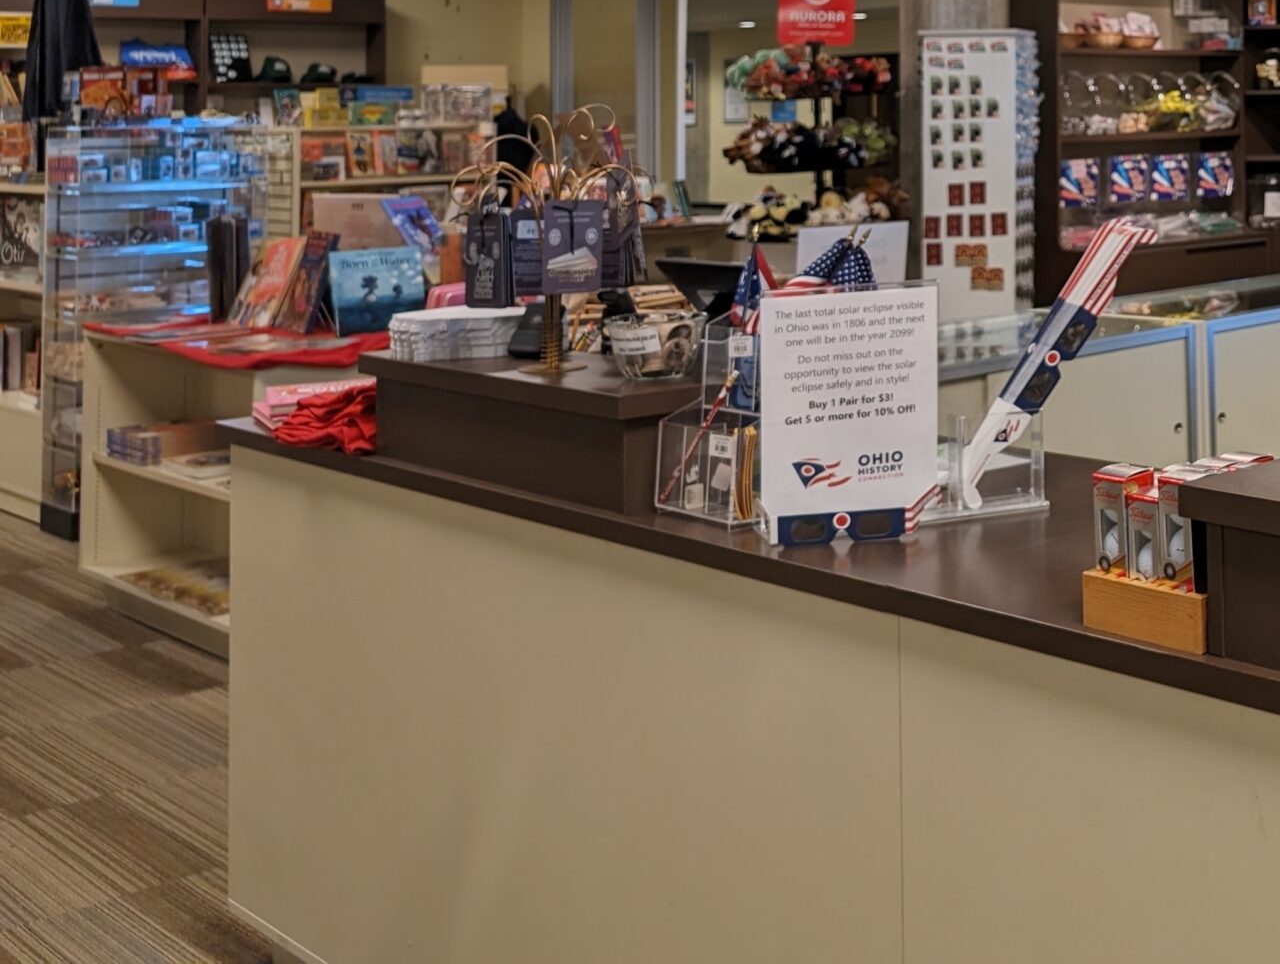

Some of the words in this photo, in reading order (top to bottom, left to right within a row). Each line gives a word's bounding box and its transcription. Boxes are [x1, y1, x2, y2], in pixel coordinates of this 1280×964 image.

[789, 10, 846, 24] AURORA
[776, 310, 792, 319] The
[795, 309, 812, 318] last
[814, 307, 836, 317] total
[838, 306, 860, 315] solar
[864, 304, 894, 315] eclipse
[897, 300, 925, 310] visible
[774, 325, 783, 334] in
[786, 323, 809, 333] Ohio
[832, 320, 841, 329] in
[844, 318, 866, 328] 1806
[868, 316, 886, 327] and
[888, 316, 903, 325] the
[906, 314, 925, 323] next
[786, 338, 803, 347] one
[806, 334, 822, 345] will
[824, 334, 837, 344] be
[839, 333, 848, 343] in
[850, 332, 865, 342] the
[868, 332, 887, 343] year
[890, 328, 915, 339] 2099!
[798, 355, 812, 364] Do
[814, 354, 830, 363] not
[833, 352, 853, 361] miss
[856, 351, 872, 360] out
[874, 350, 887, 358] on
[888, 347, 904, 357] the
[784, 366, 840, 381] opportunity
[842, 366, 853, 375] to
[854, 364, 876, 374] view
[878, 362, 893, 371] the
[895, 360, 917, 370] solar
[792, 381, 824, 394] eclipse
[826, 378, 853, 391] safely
[855, 376, 873, 387] and
[875, 375, 884, 385] in
[886, 374, 910, 386] style!
[808, 400, 828, 411] Buy
[831, 399, 836, 407] 1
[840, 396, 859, 406] Pair
[861, 394, 876, 404] for
[878, 392, 894, 404] $3!
[785, 415, 803, 426] Get
[806, 414, 812, 424] 5
[814, 414, 826, 423] or
[828, 411, 854, 422] more
[856, 409, 872, 419] for
[874, 406, 895, 417] 10%
[898, 404, 916, 415] Off!
[858, 450, 904, 467] OHIO
[858, 463, 903, 476] HISTORY
